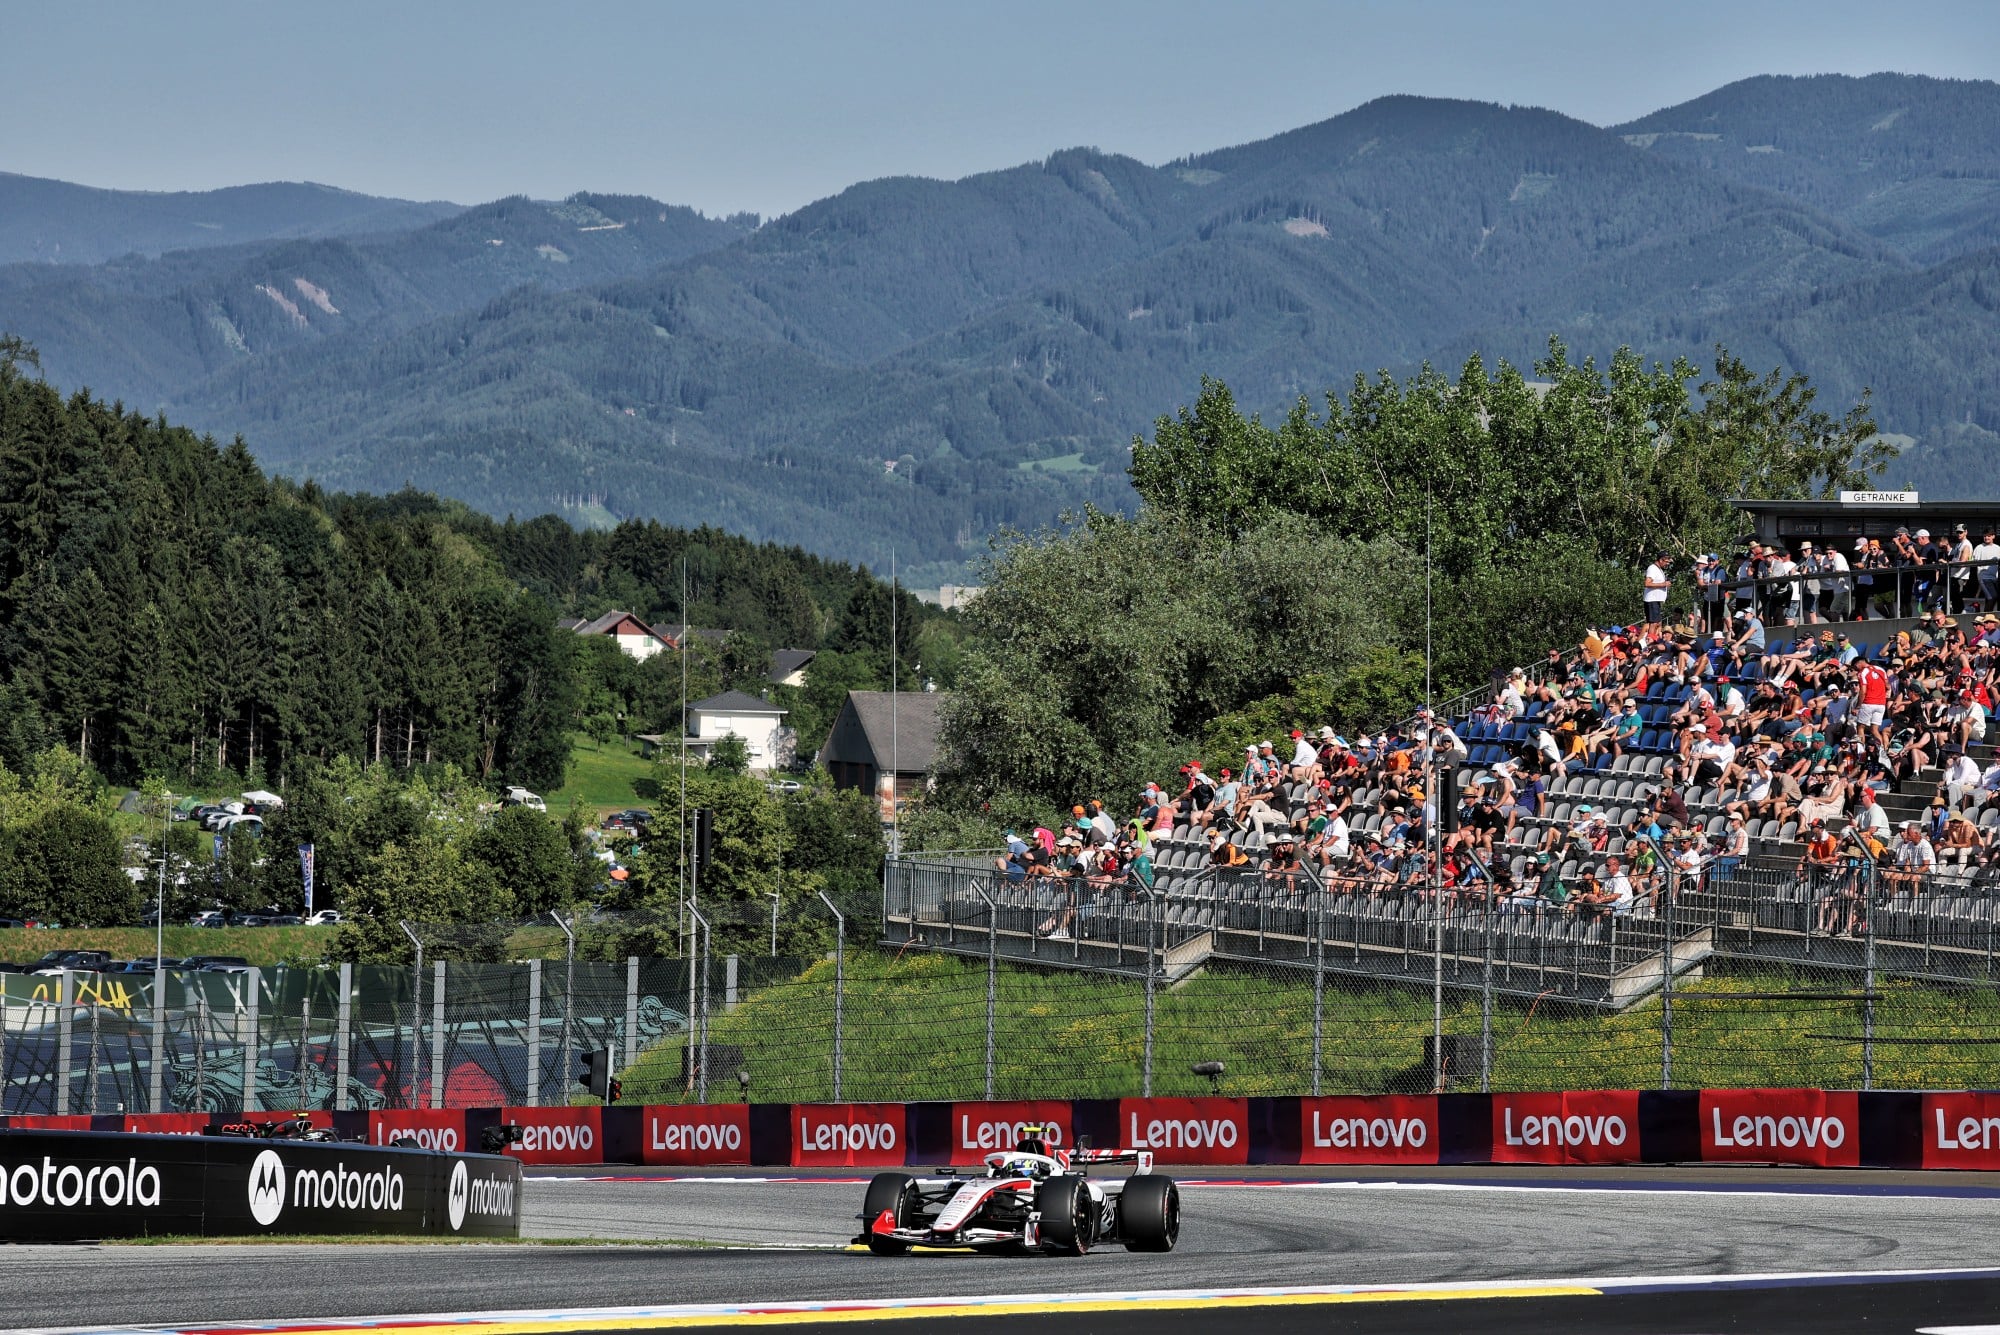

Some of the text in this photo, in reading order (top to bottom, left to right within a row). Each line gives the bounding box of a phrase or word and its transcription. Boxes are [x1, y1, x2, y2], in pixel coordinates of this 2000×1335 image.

[1853, 492, 1905, 501] GETRÄNKE
[652, 1117, 741, 1151] Lenovo
[802, 1117, 896, 1151] Lenovo
[1131, 1111, 1238, 1149] Lenovo
[1313, 1110, 1427, 1148] Lenovo
[1505, 1107, 1627, 1146] Lenovo
[1713, 1107, 1845, 1148] Lenovo
[293, 1162, 404, 1211] motorola
